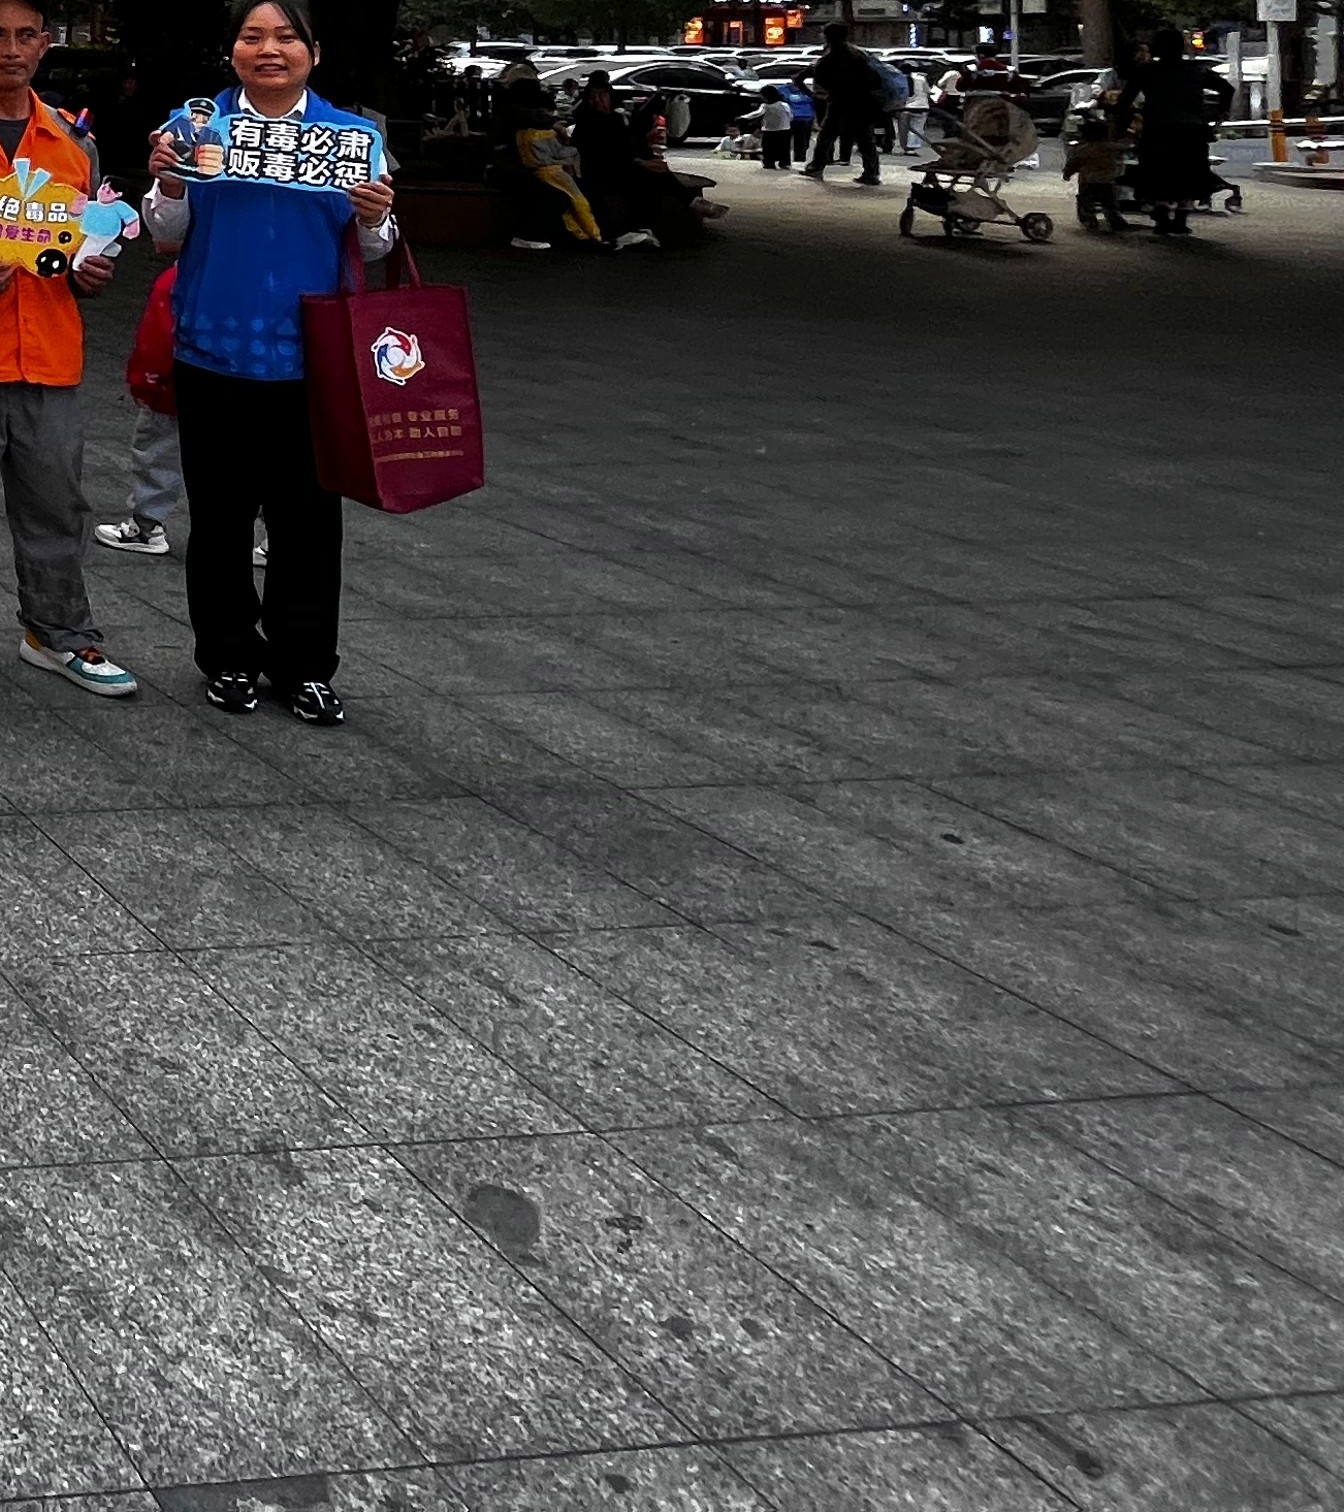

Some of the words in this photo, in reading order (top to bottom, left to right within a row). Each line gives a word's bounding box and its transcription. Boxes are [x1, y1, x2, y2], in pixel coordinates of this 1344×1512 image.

[230, 117, 372, 162] 有毒必肃
[227, 148, 370, 189] 贩毒必惩
